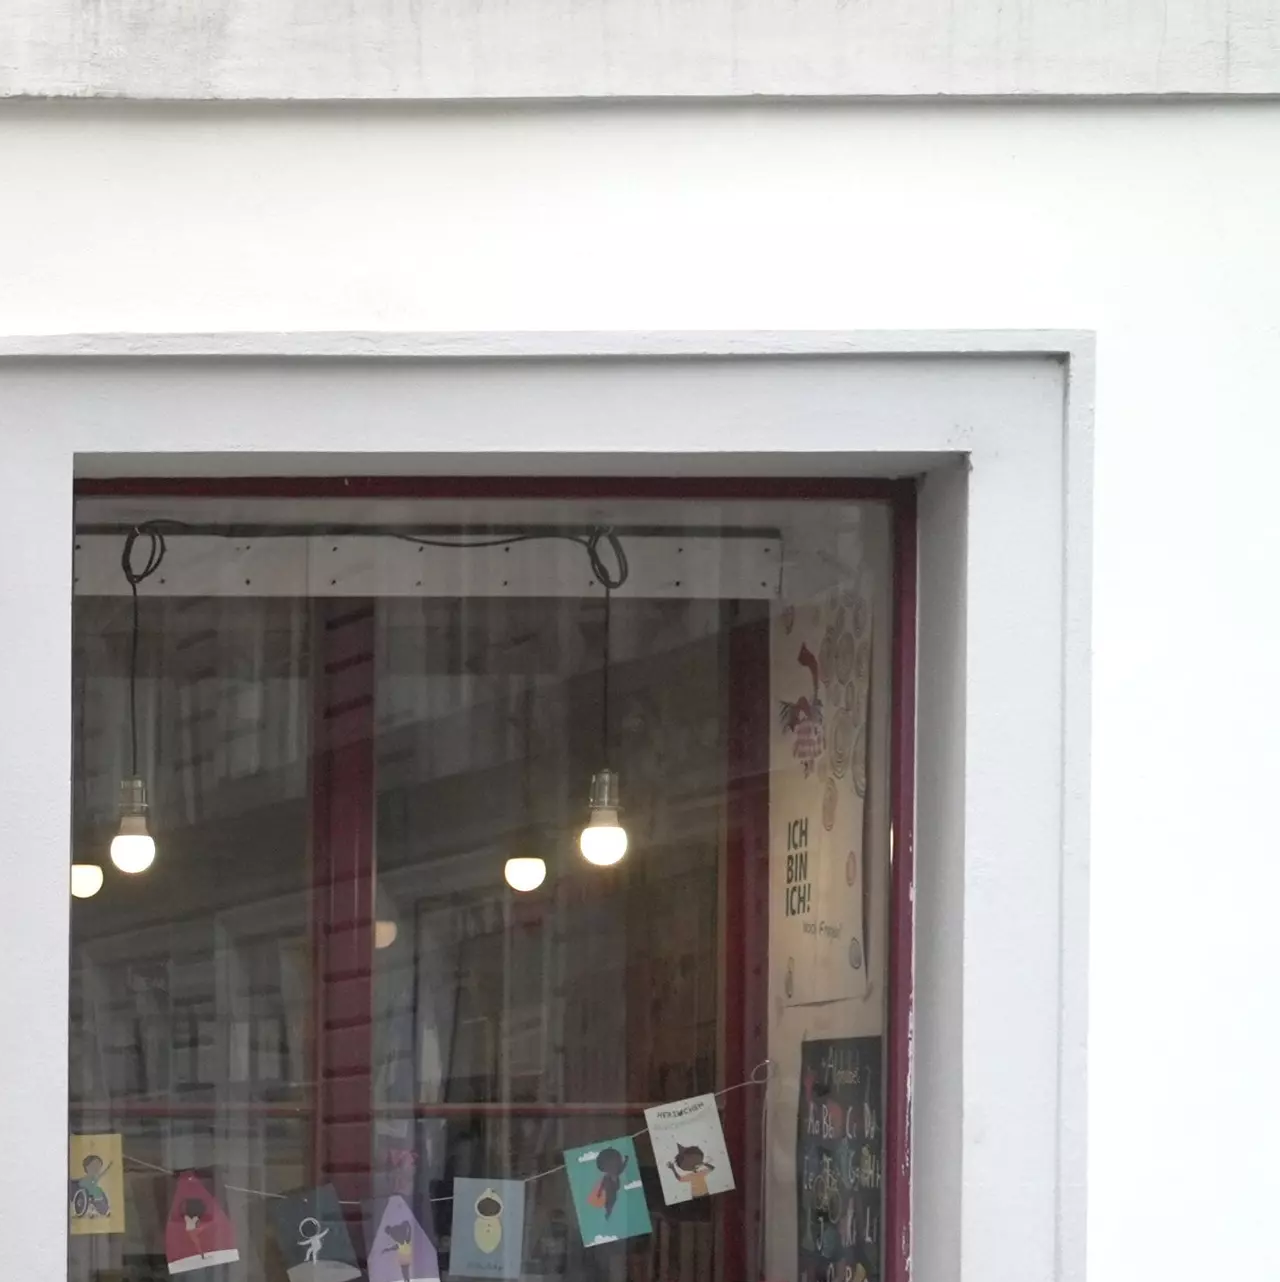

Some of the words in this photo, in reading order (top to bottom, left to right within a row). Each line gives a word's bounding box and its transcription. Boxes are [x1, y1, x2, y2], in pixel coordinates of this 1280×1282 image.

[787, 817, 808, 851] ICH
[786, 851, 808, 884] BIN
[785, 883, 811, 917] ICH!
